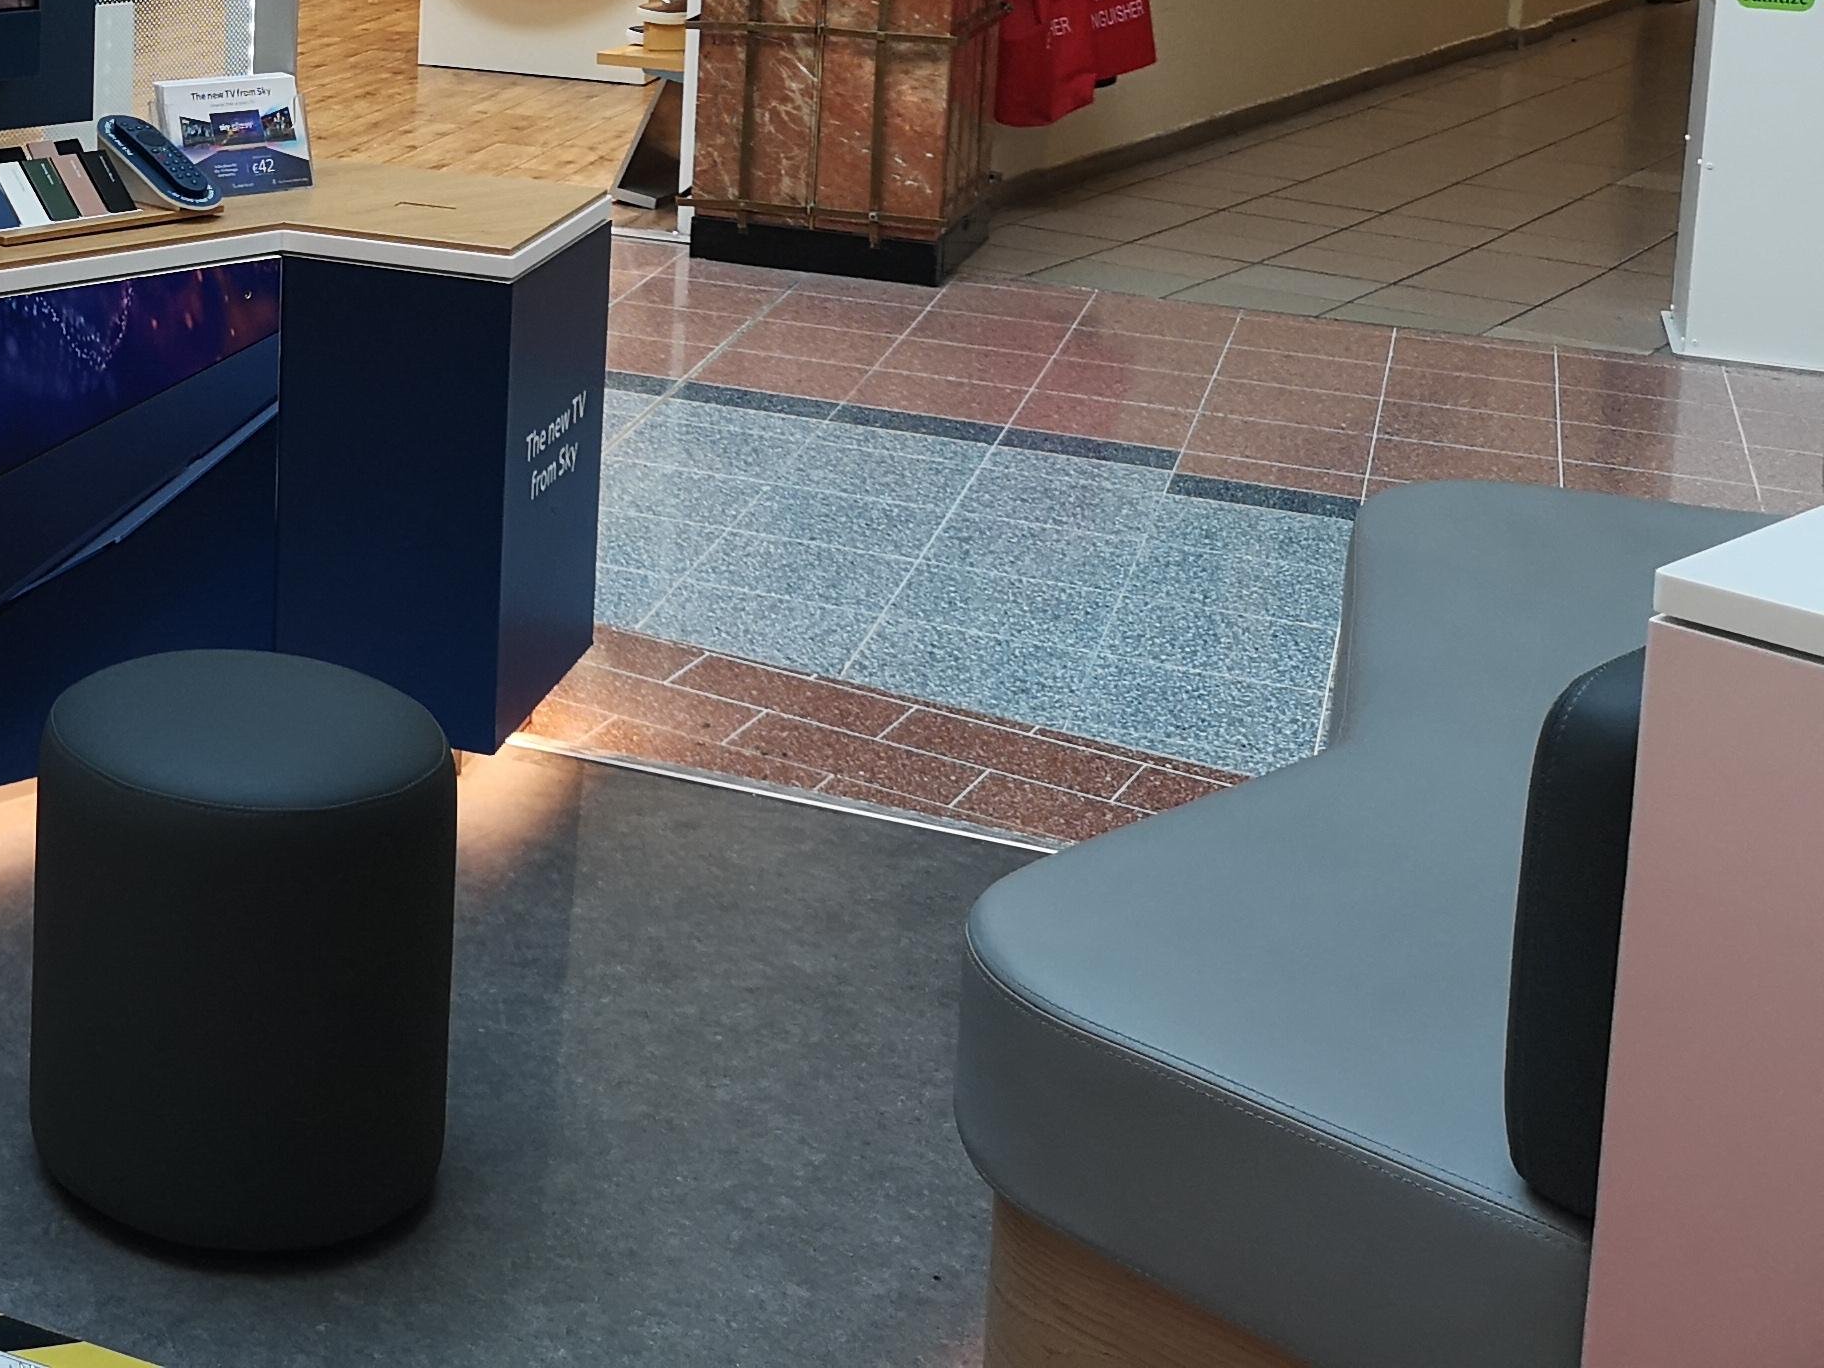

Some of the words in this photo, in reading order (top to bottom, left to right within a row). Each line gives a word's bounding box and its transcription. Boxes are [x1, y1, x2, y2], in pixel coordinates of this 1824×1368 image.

[191, 92, 206, 101] The
[207, 92, 224, 100] new
[225, 89, 236, 99] TV
[236, 88, 257, 97] from
[257, 87, 271, 97] Sky
[252, 158, 276, 174] €42
[526, 429, 547, 462] The
[548, 408, 571, 445] new
[571, 389, 587, 425] TV
[530, 460, 558, 501] from
[558, 441, 579, 477] Sky
